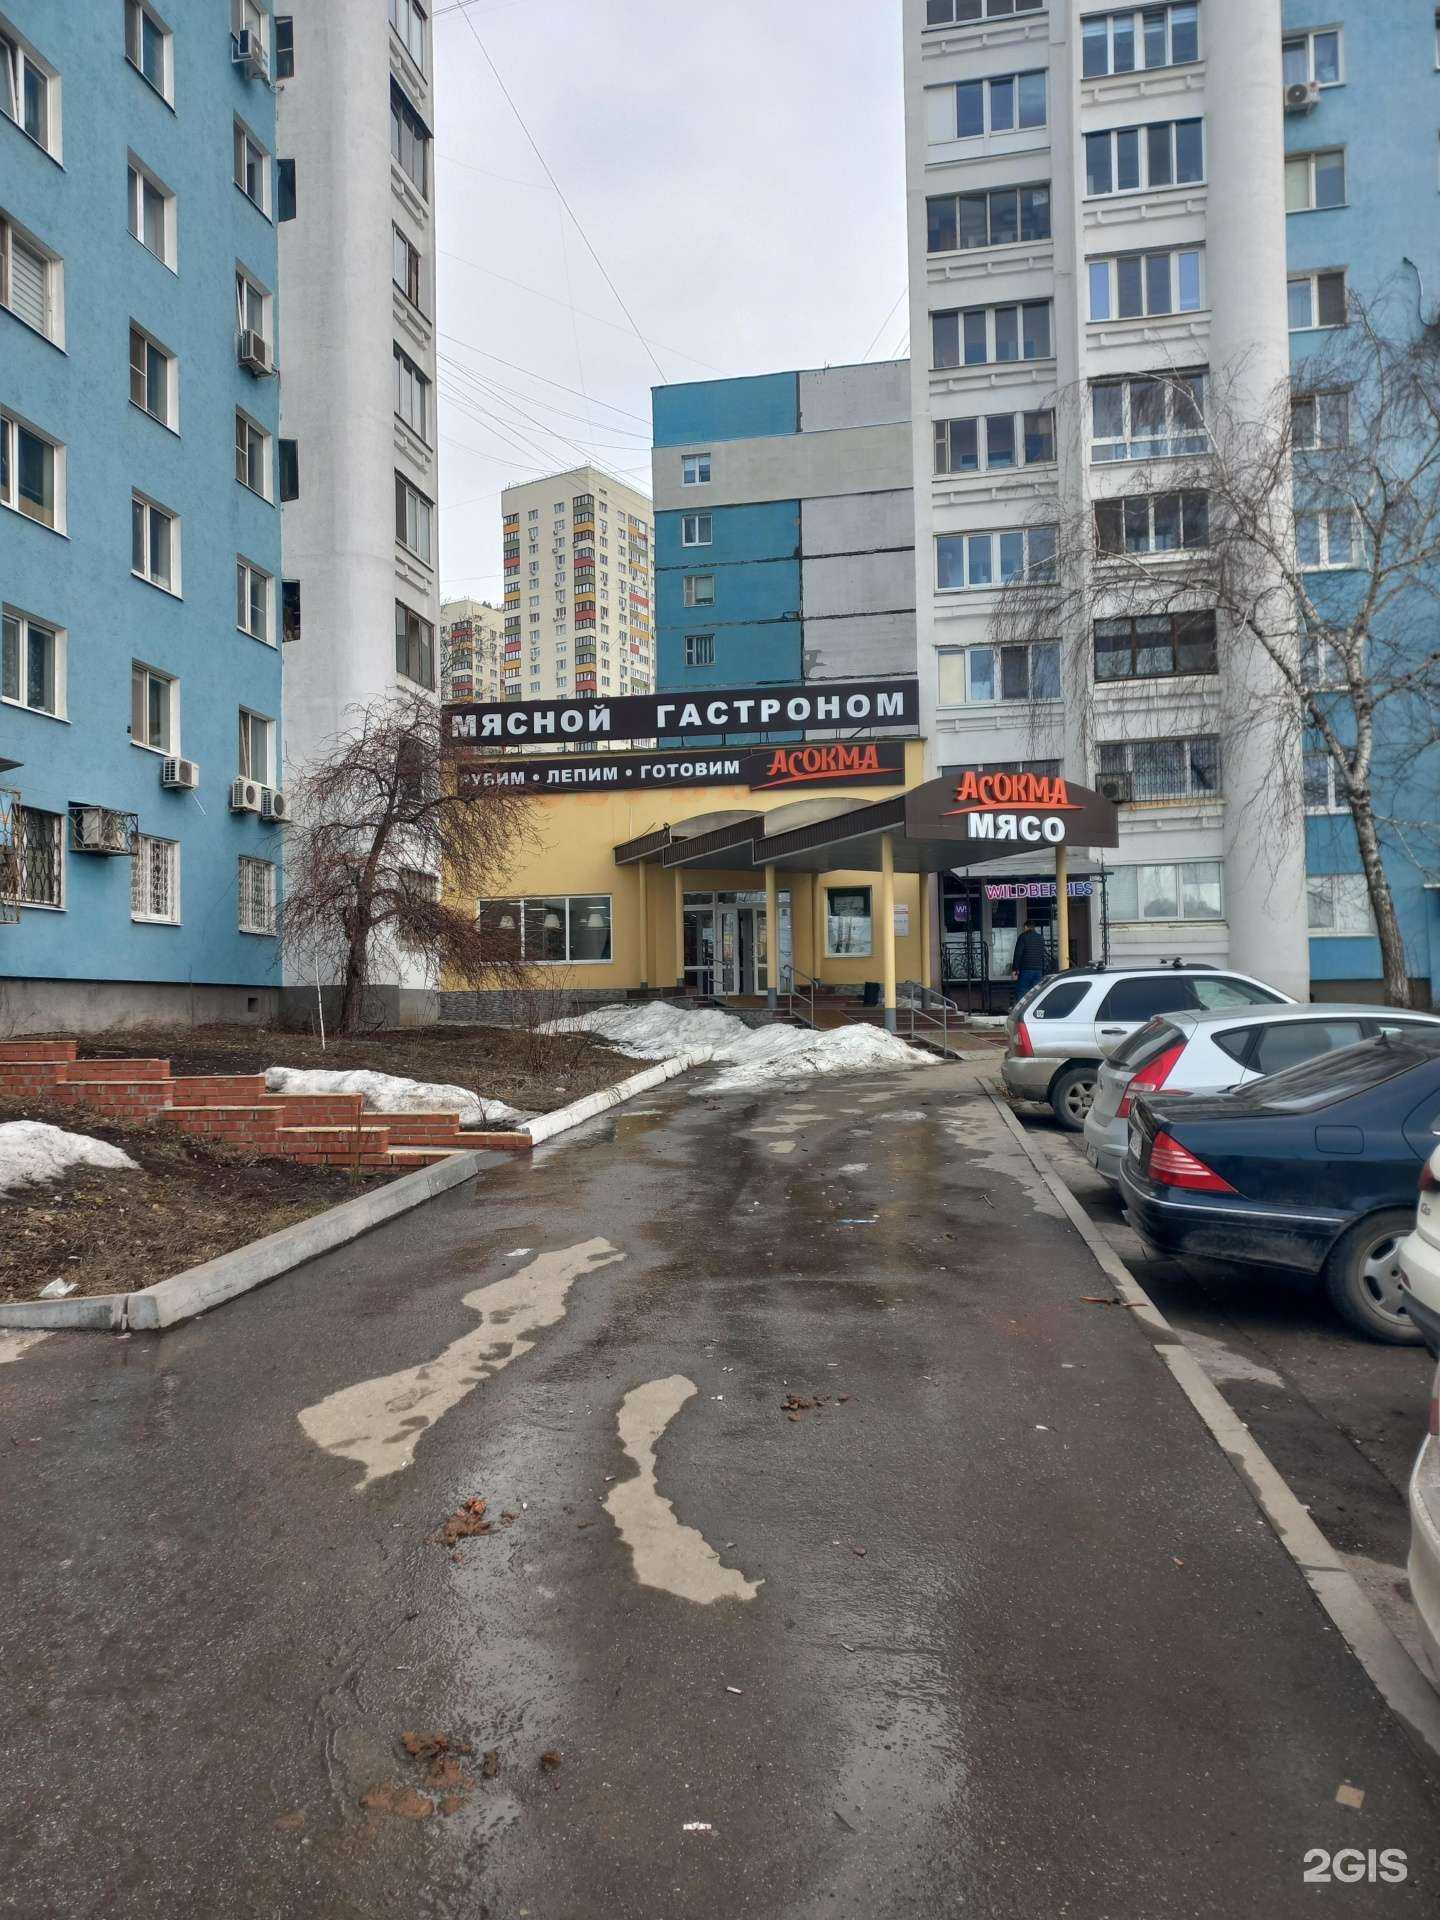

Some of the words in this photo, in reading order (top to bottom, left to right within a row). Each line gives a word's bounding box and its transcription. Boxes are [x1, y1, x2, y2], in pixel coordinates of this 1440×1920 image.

[451, 704, 611, 738] МЯСНОЙ
[657, 692, 904, 728] ГАСТРОНОМ
[546, 766, 618, 784] ЛЕПИМ
[640, 760, 740, 779] ГОТОВИМ
[967, 812, 1066, 843] МЯСО
[985, 882, 1094, 900] WILDBERIES
